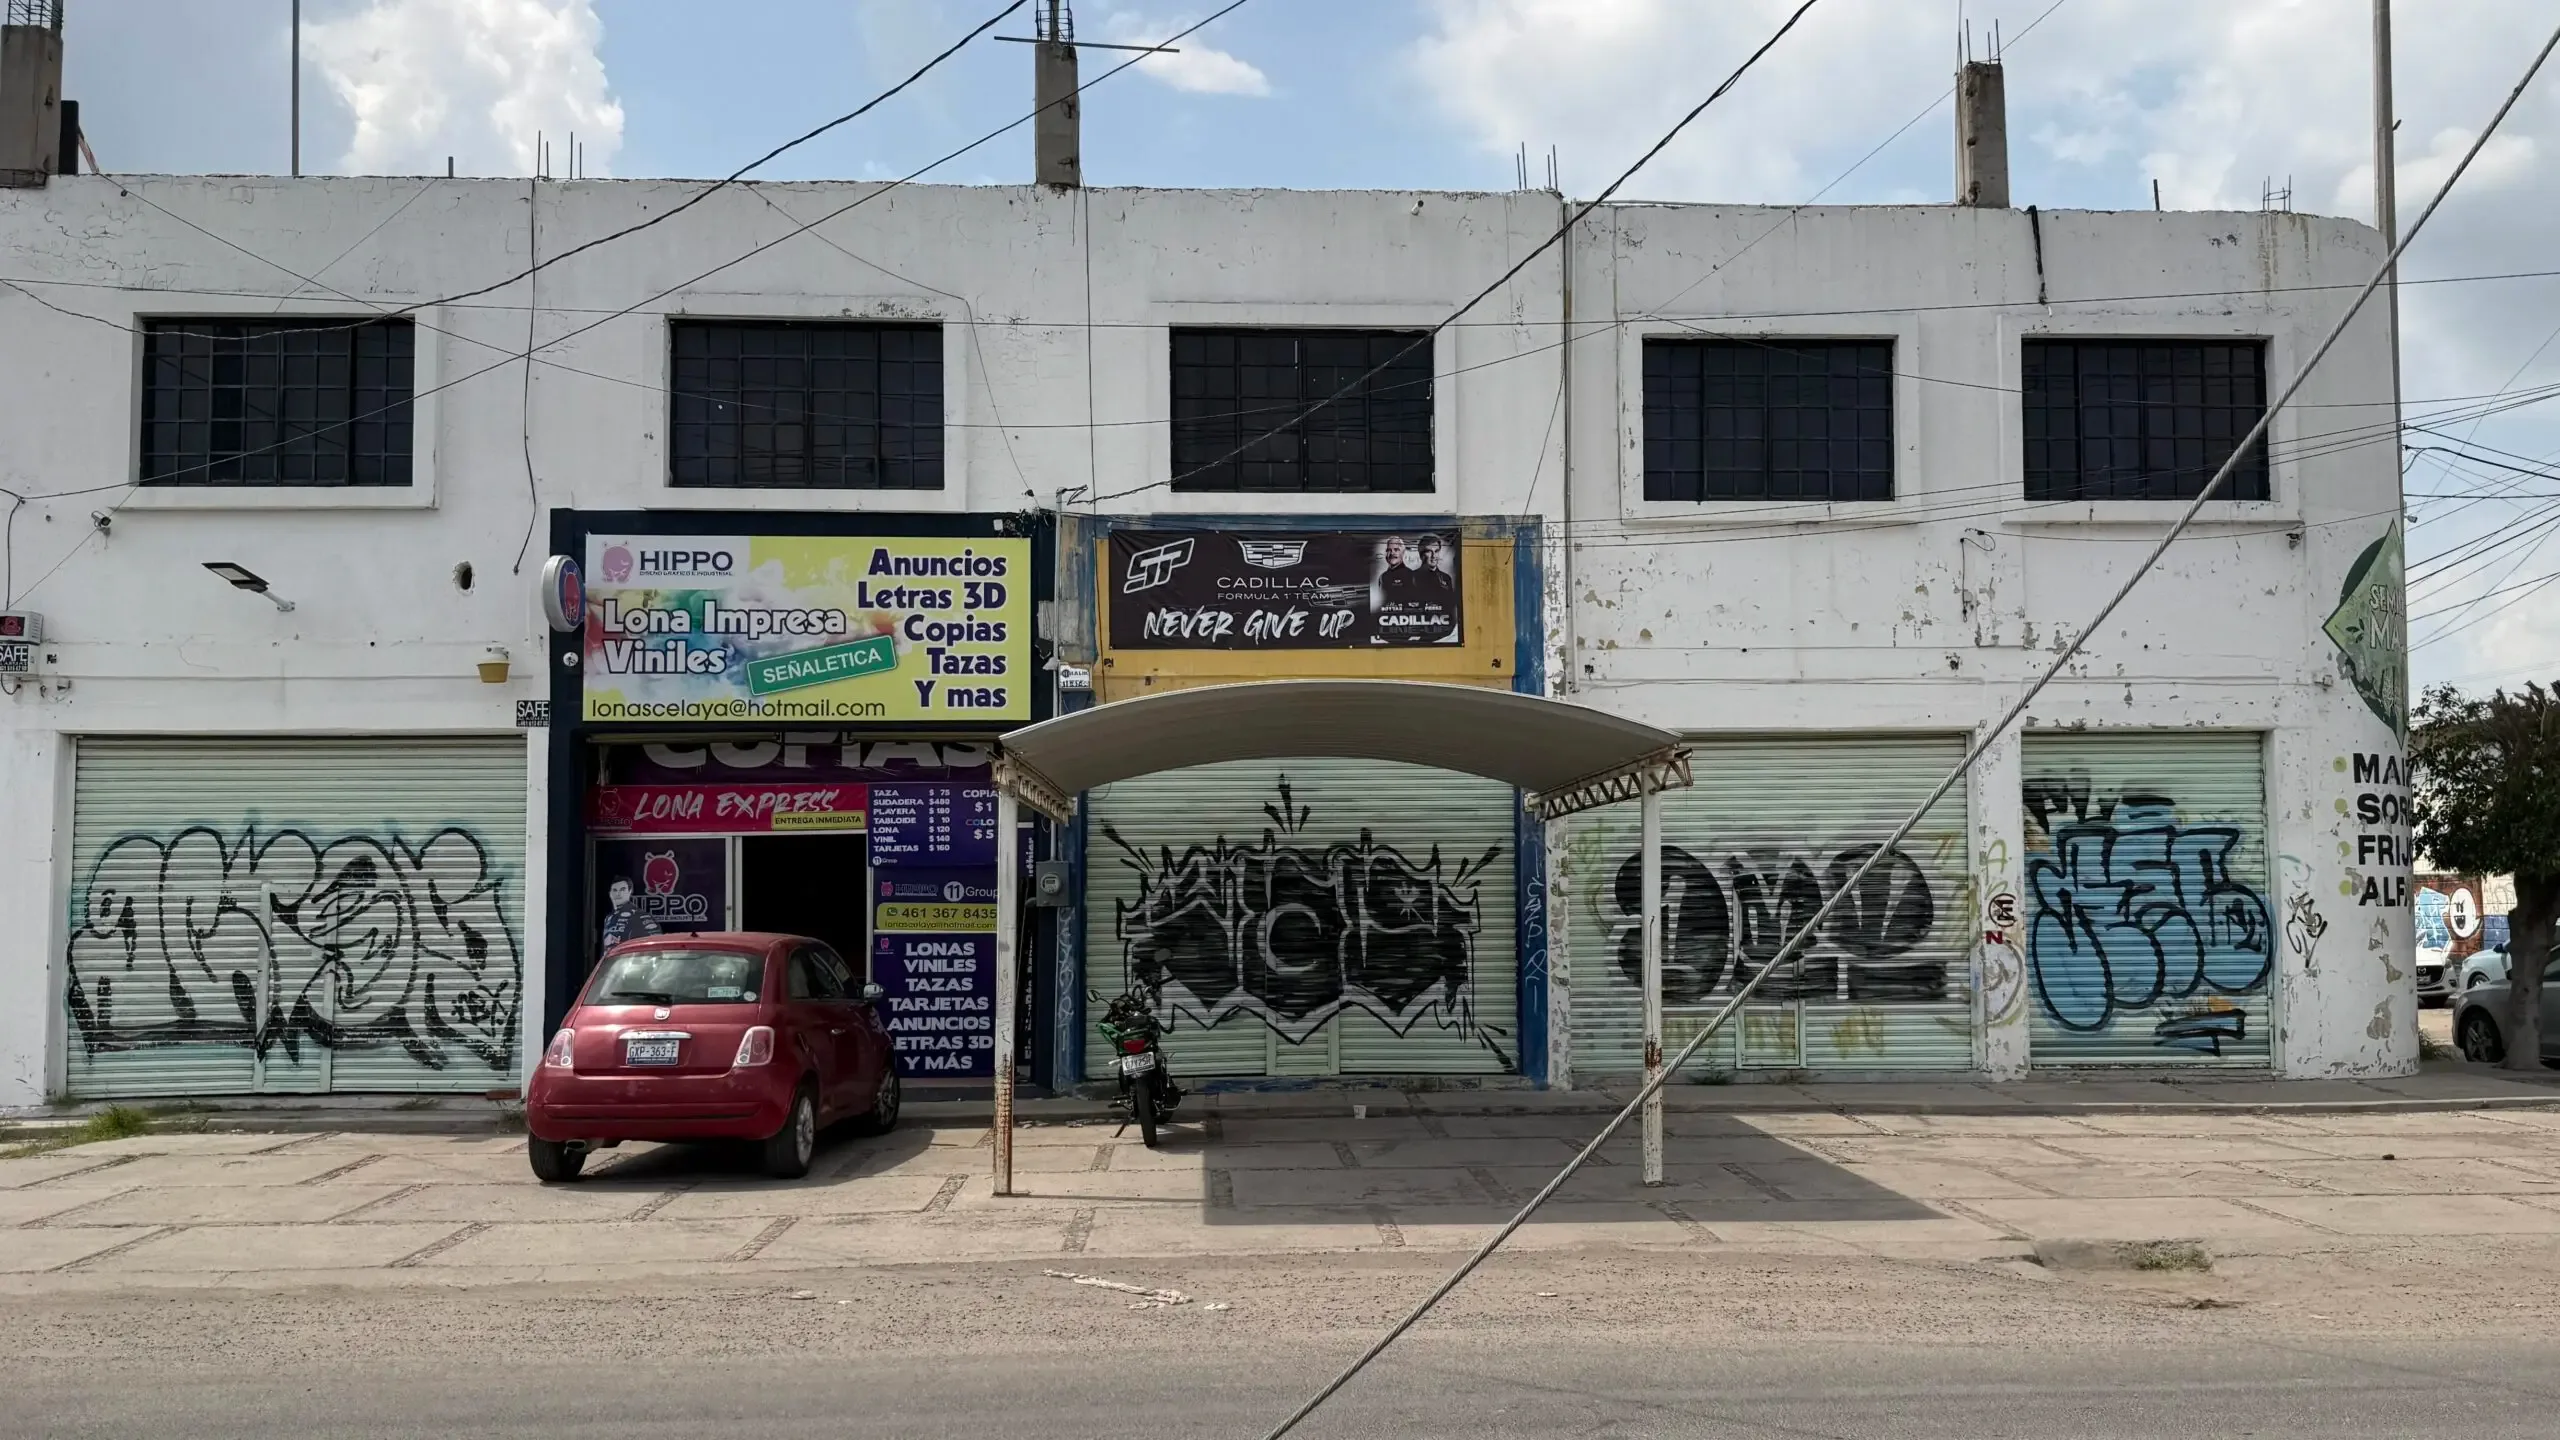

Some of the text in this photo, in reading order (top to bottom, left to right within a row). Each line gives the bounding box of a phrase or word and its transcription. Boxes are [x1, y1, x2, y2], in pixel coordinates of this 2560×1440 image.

[640, 551, 733, 571] HIPPO
[868, 549, 1006, 576] Anuncios
[1217, 577, 1329, 588] CADILLAC
[858, 581, 1006, 609] Letras 3D
[603, 599, 846, 640] Lona Impresa
[1144, 605, 1355, 645] NEVER GIVE UP
[1379, 615, 1449, 625] CADILLAC
[904, 614, 1006, 646] Copias
[603, 639, 727, 674] Viniles
[927, 648, 1006, 674] Tazas
[763, 648, 882, 684] SEÑALETICA
[914, 680, 1006, 707] Y mas
[518, 702, 548, 717] SAFE
[592, 699, 885, 720] lonascelaya@hotmail.com
[963, 790, 1000, 798] COPIA
[633, 789, 839, 821] LONA EXPRESS
[975, 801, 992, 813] $ 1
[775, 816, 861, 825] ENTREGA INMEDIATA
[974, 828, 994, 840] $ 5
[947, 885, 960, 898] 11
[902, 908, 997, 919] 461 367 8435
[905, 942, 975, 956] LONAS
[904, 959, 977, 973] VINILES
[905, 978, 973, 991] TAZAS
[888, 997, 989, 1011] TARJETAS
[887, 1016, 990, 1031] ANUNCIOS
[895, 1036, 993, 1050] ETRAS 3D
[629, 1046, 676, 1057] GXP-363-F
[904, 1052, 972, 1070] Y MÁS
